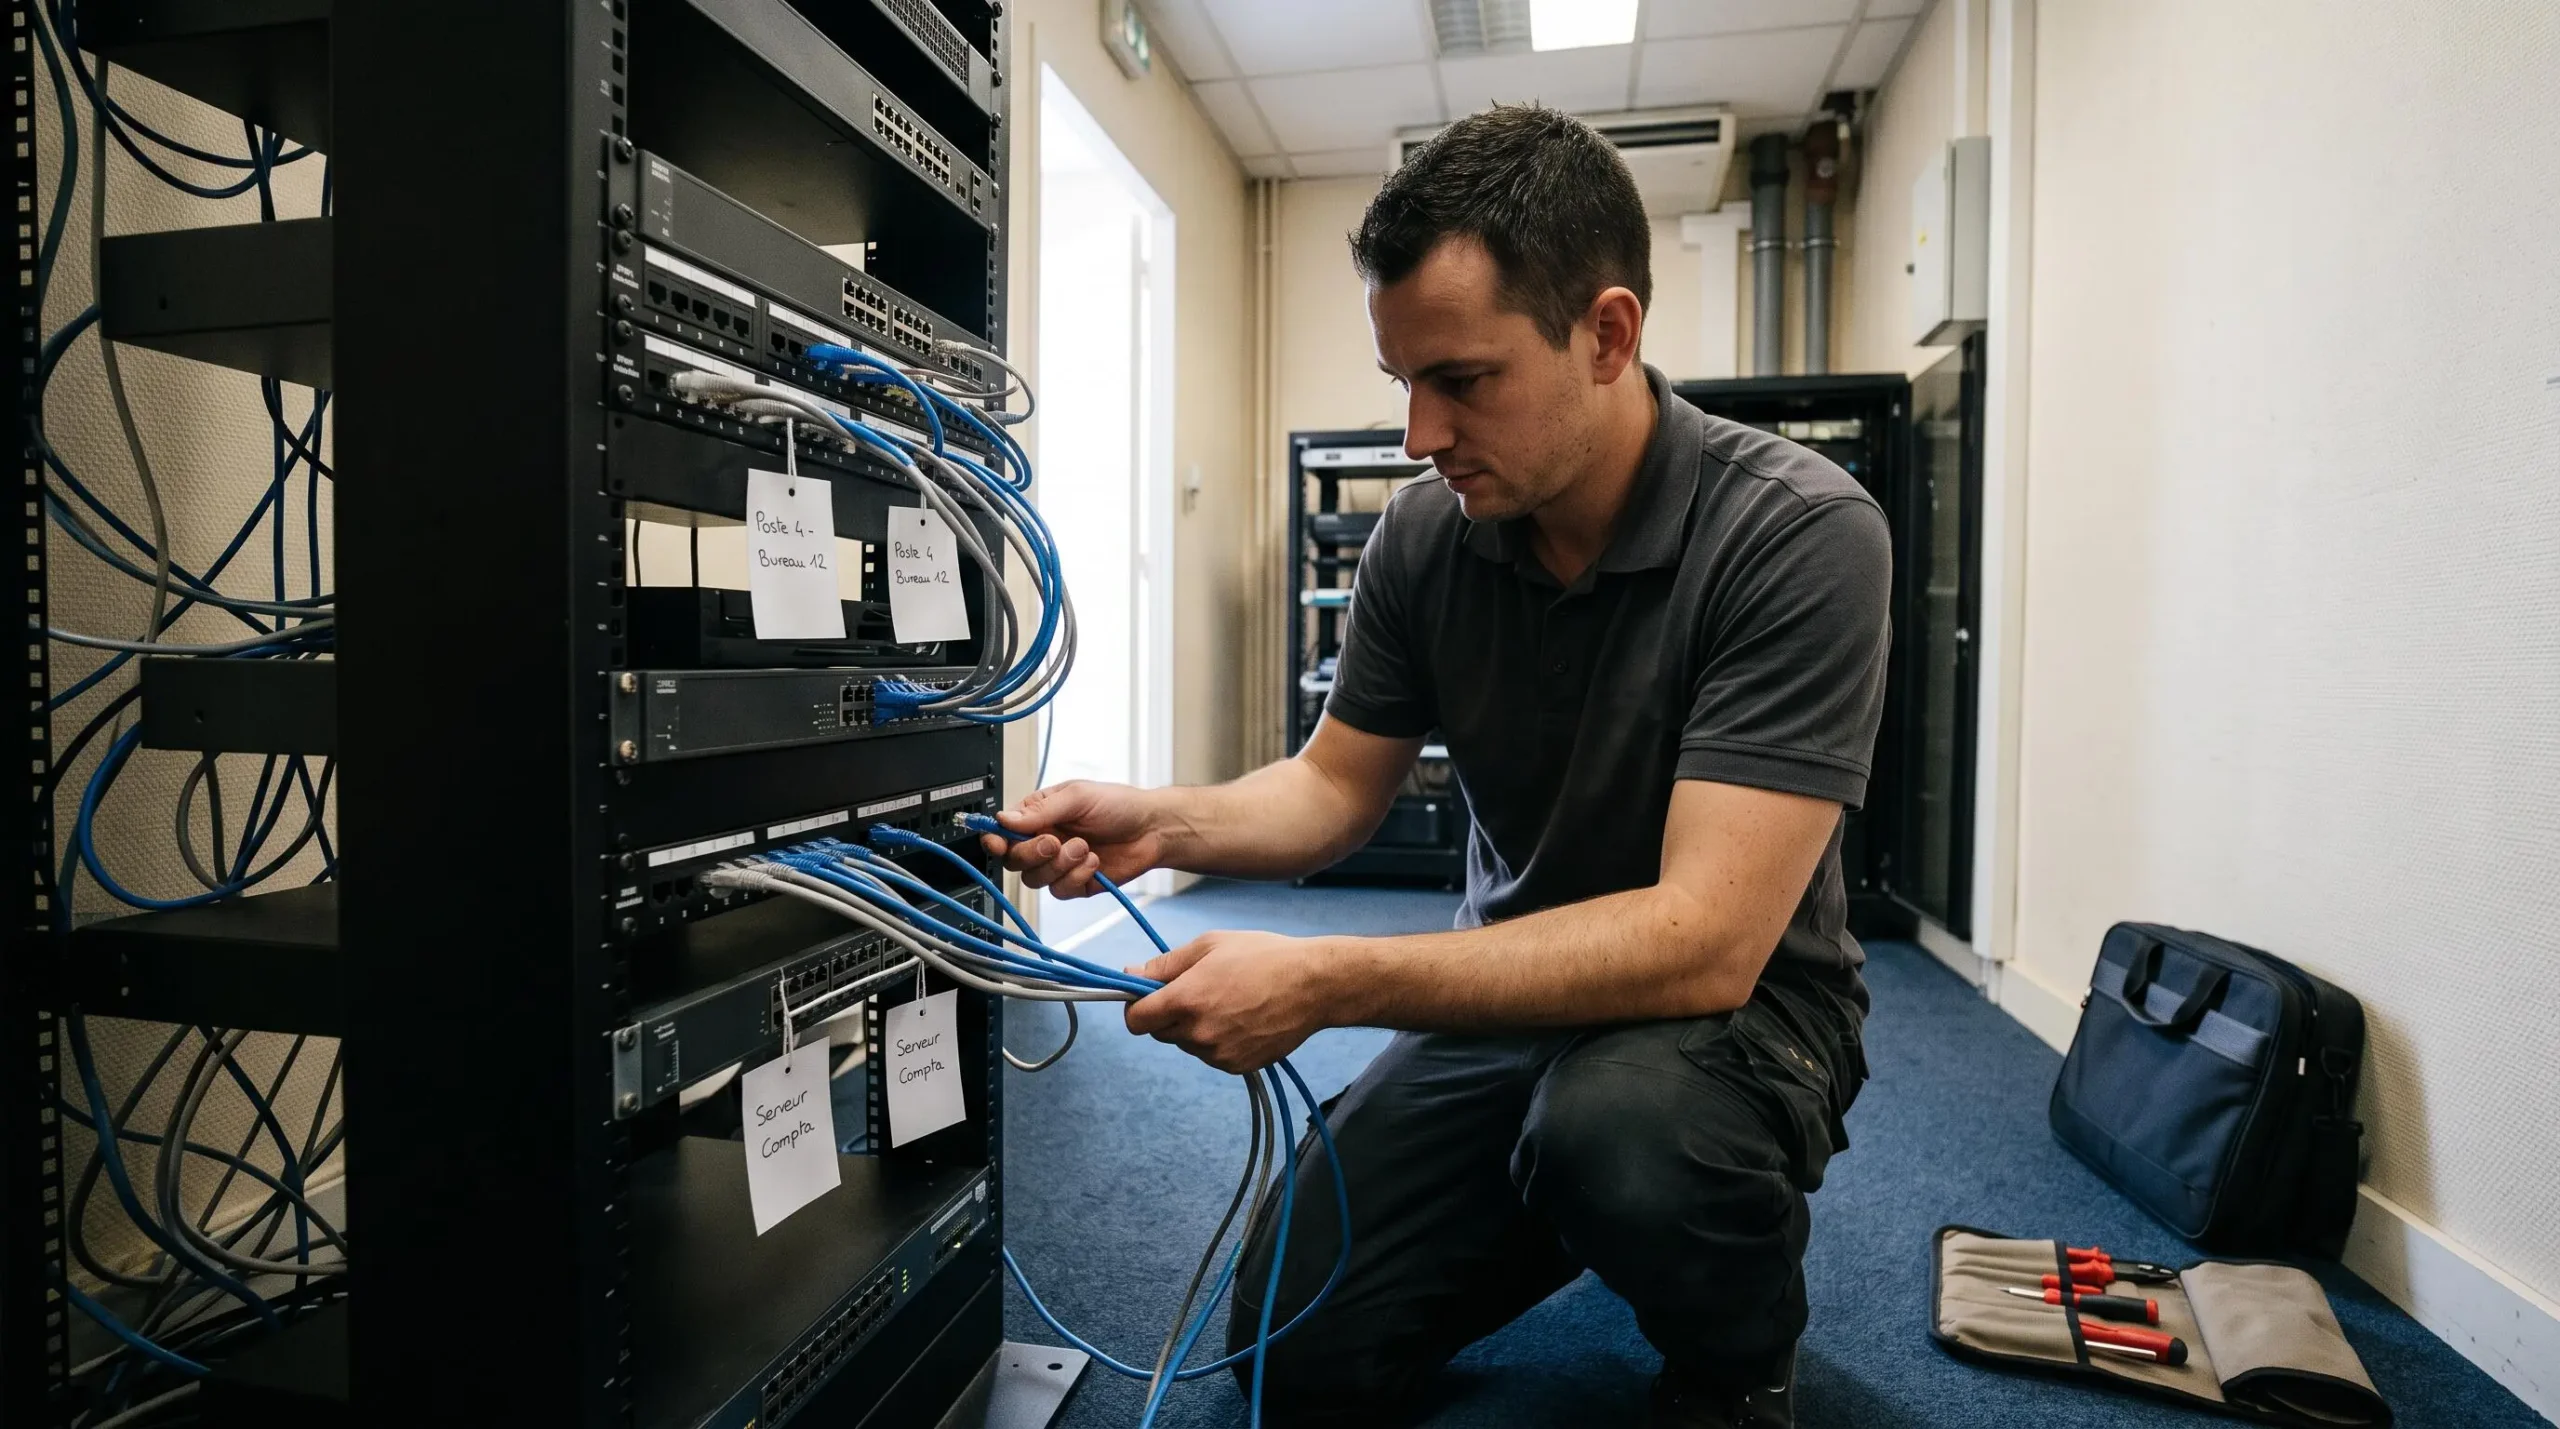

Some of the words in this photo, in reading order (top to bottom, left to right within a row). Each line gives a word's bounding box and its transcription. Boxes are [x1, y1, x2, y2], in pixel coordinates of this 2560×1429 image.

[755, 510, 789, 535] Poste
[757, 548, 806, 569] Bureau
[809, 553, 828, 570] 12
[926, 545, 934, 562] 4
[895, 569, 931, 585] Bureau
[934, 570, 950, 584] 12
[896, 1033, 941, 1057] Serveur
[898, 1058, 945, 1085] Compta
[755, 1090, 808, 1127] Serveur
[761, 1120, 816, 1159] Compta
